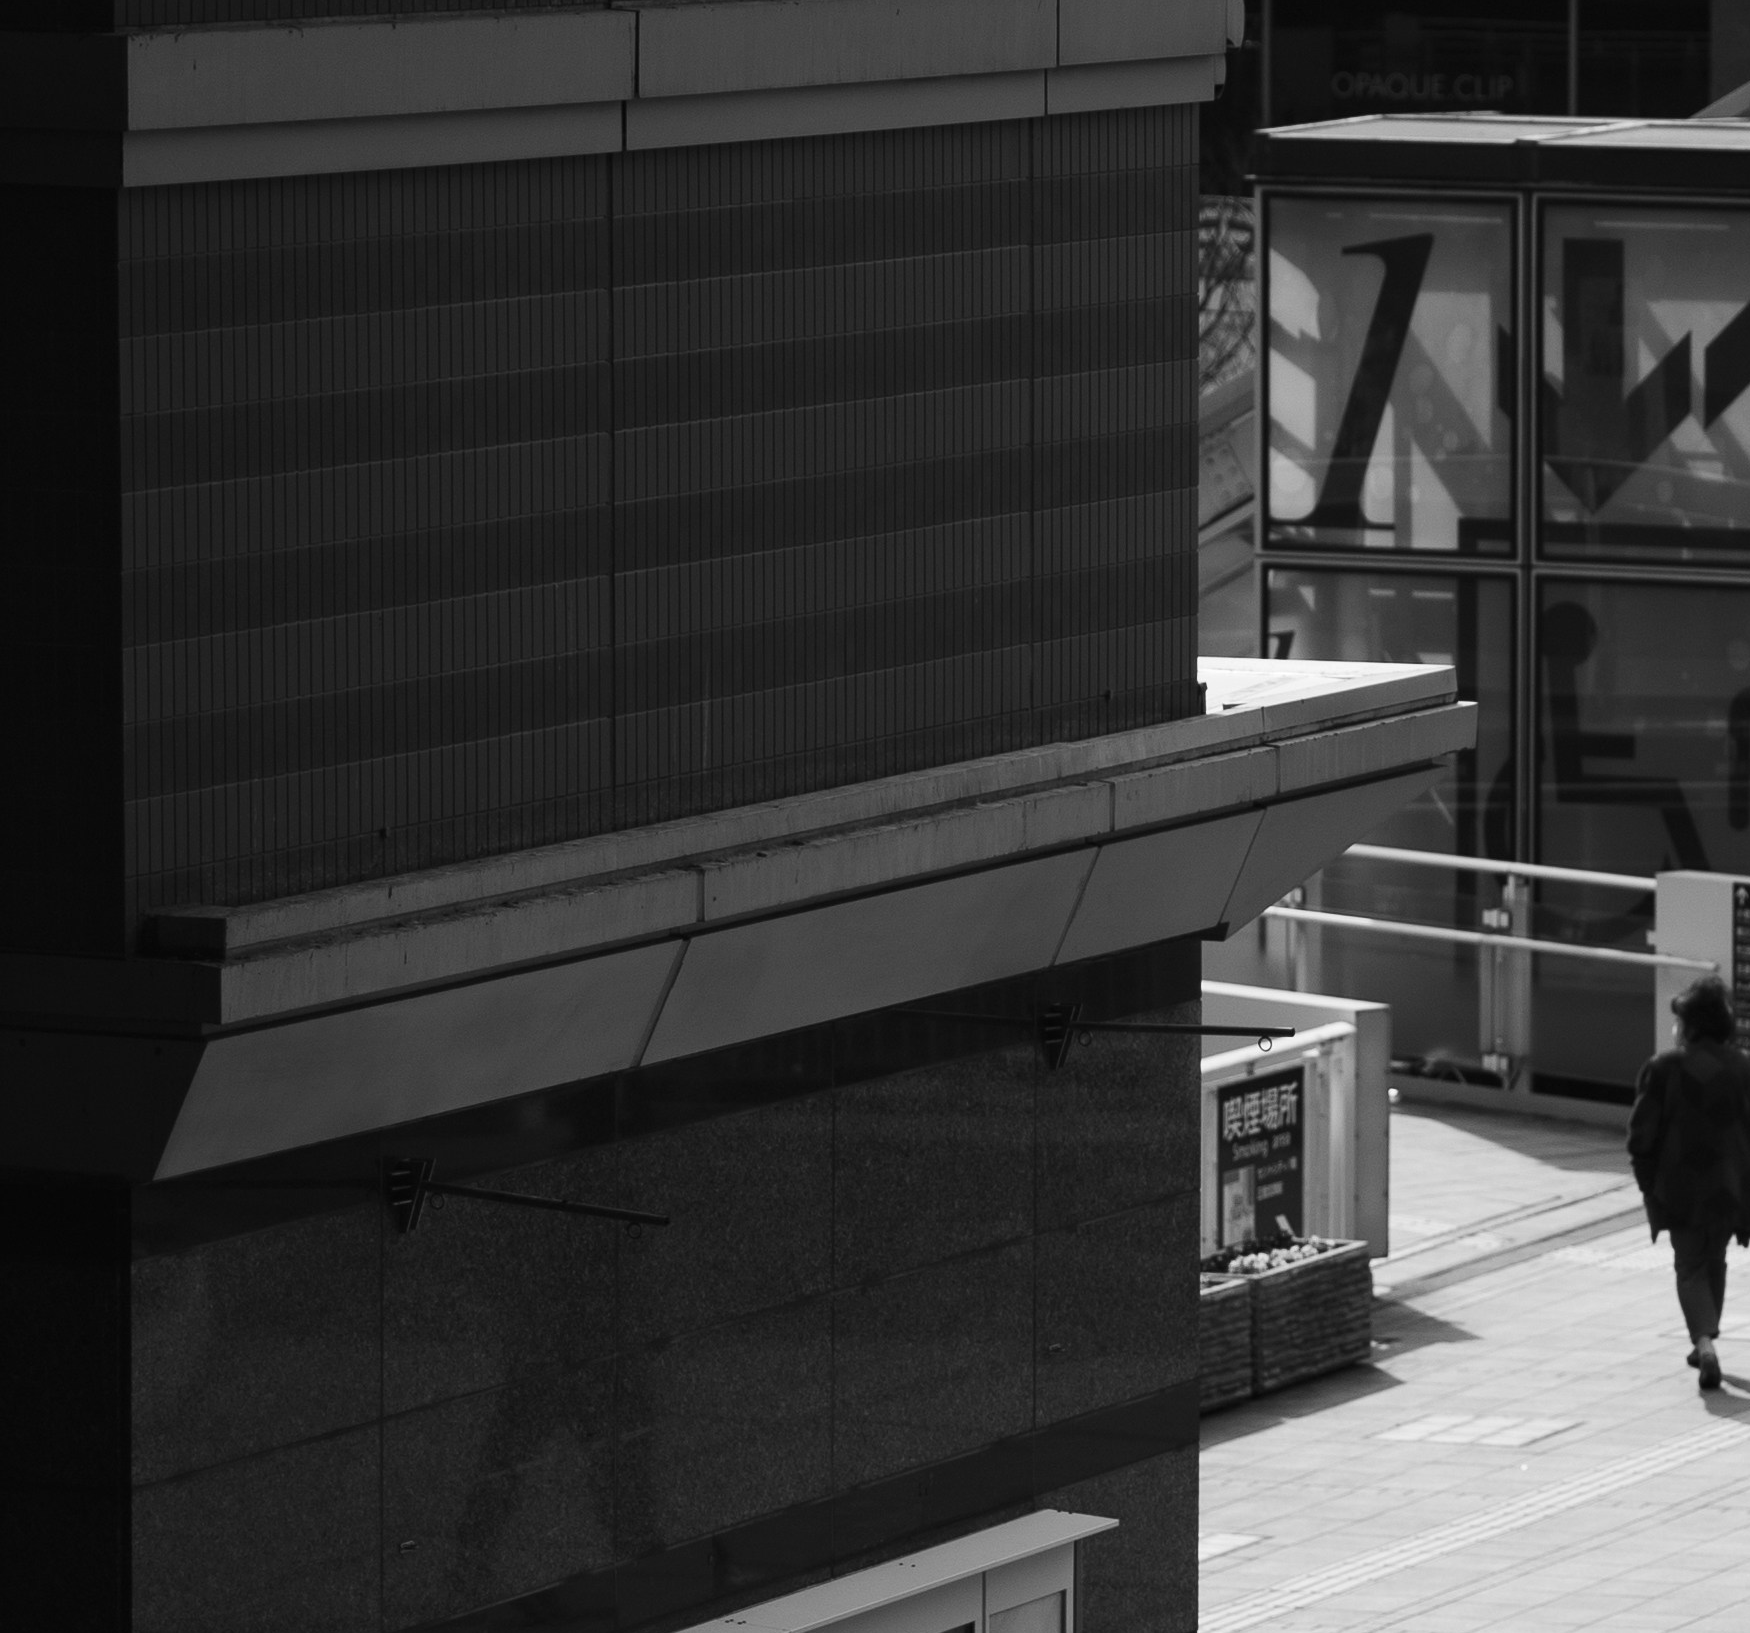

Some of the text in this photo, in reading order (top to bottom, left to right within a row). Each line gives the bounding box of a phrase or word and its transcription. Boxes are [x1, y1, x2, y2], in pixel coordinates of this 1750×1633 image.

[1222, 1079, 1299, 1143] 喫煙場所
[1231, 1139, 1269, 1162] Smoking
